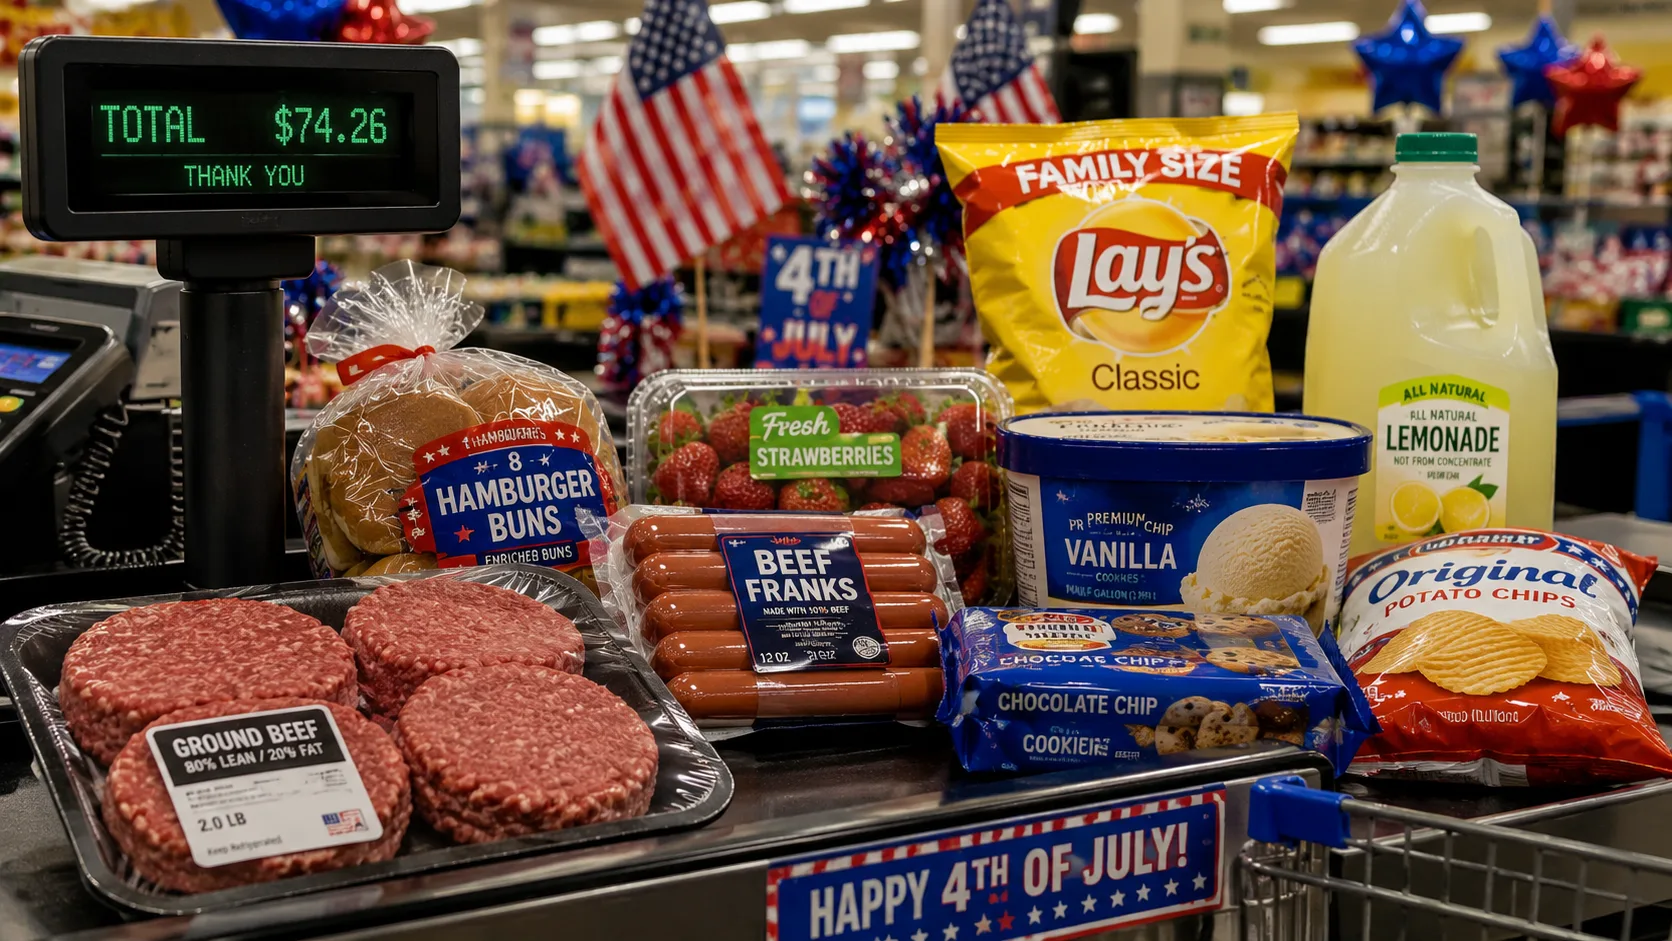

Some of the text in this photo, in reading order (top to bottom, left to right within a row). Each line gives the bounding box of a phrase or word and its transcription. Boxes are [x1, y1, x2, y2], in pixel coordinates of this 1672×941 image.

[100, 104, 387, 146] TOTAL $74.26
[184, 165, 304, 187] THANK YOU
[1015, 151, 1242, 195] FAMILY SIZE
[774, 244, 860, 306] 4TH
[1067, 233, 1217, 321] Lay's
[772, 318, 858, 366] JULY
[1091, 363, 1200, 391] Classic
[1403, 382, 1486, 403] ALL NATURAL
[761, 411, 831, 442] Fresh
[1410, 410, 1477, 422] ALL NATURAL
[1386, 424, 1500, 453] LEMONADE
[508, 451, 523, 472] 8
[757, 445, 894, 467] STRAWBERRIES
[1394, 456, 1492, 468] NOT FROM CONCENTRATE
[435, 469, 596, 516] HAMBURGER
[487, 505, 562, 543] BUNS
[1144, 521, 1174, 536] CHIP
[543, 546, 573, 562] BUNS
[753, 549, 832, 576] BEEF
[1064, 538, 1177, 570] VANILLA
[745, 578, 858, 603] FRANKS
[1368, 559, 1599, 605] Original
[763, 607, 785, 616] MADE
[786, 606, 807, 615] WITH
[1384, 587, 1576, 618] POTATO CHIPS
[760, 651, 791, 664] 12 OZ
[1114, 656, 1164, 666] CHIP
[998, 692, 1158, 716] CHOCOLATE CHIP
[172, 719, 318, 759] GROUND BEEF
[184, 757, 217, 775] 80%
[218, 752, 257, 769] LEAN
[267, 746, 297, 761] 20%
[299, 742, 324, 758] FAT
[197, 811, 247, 833] 2.0 LB
[810, 822, 1188, 940] HAPPY 4TH OF JULY!
